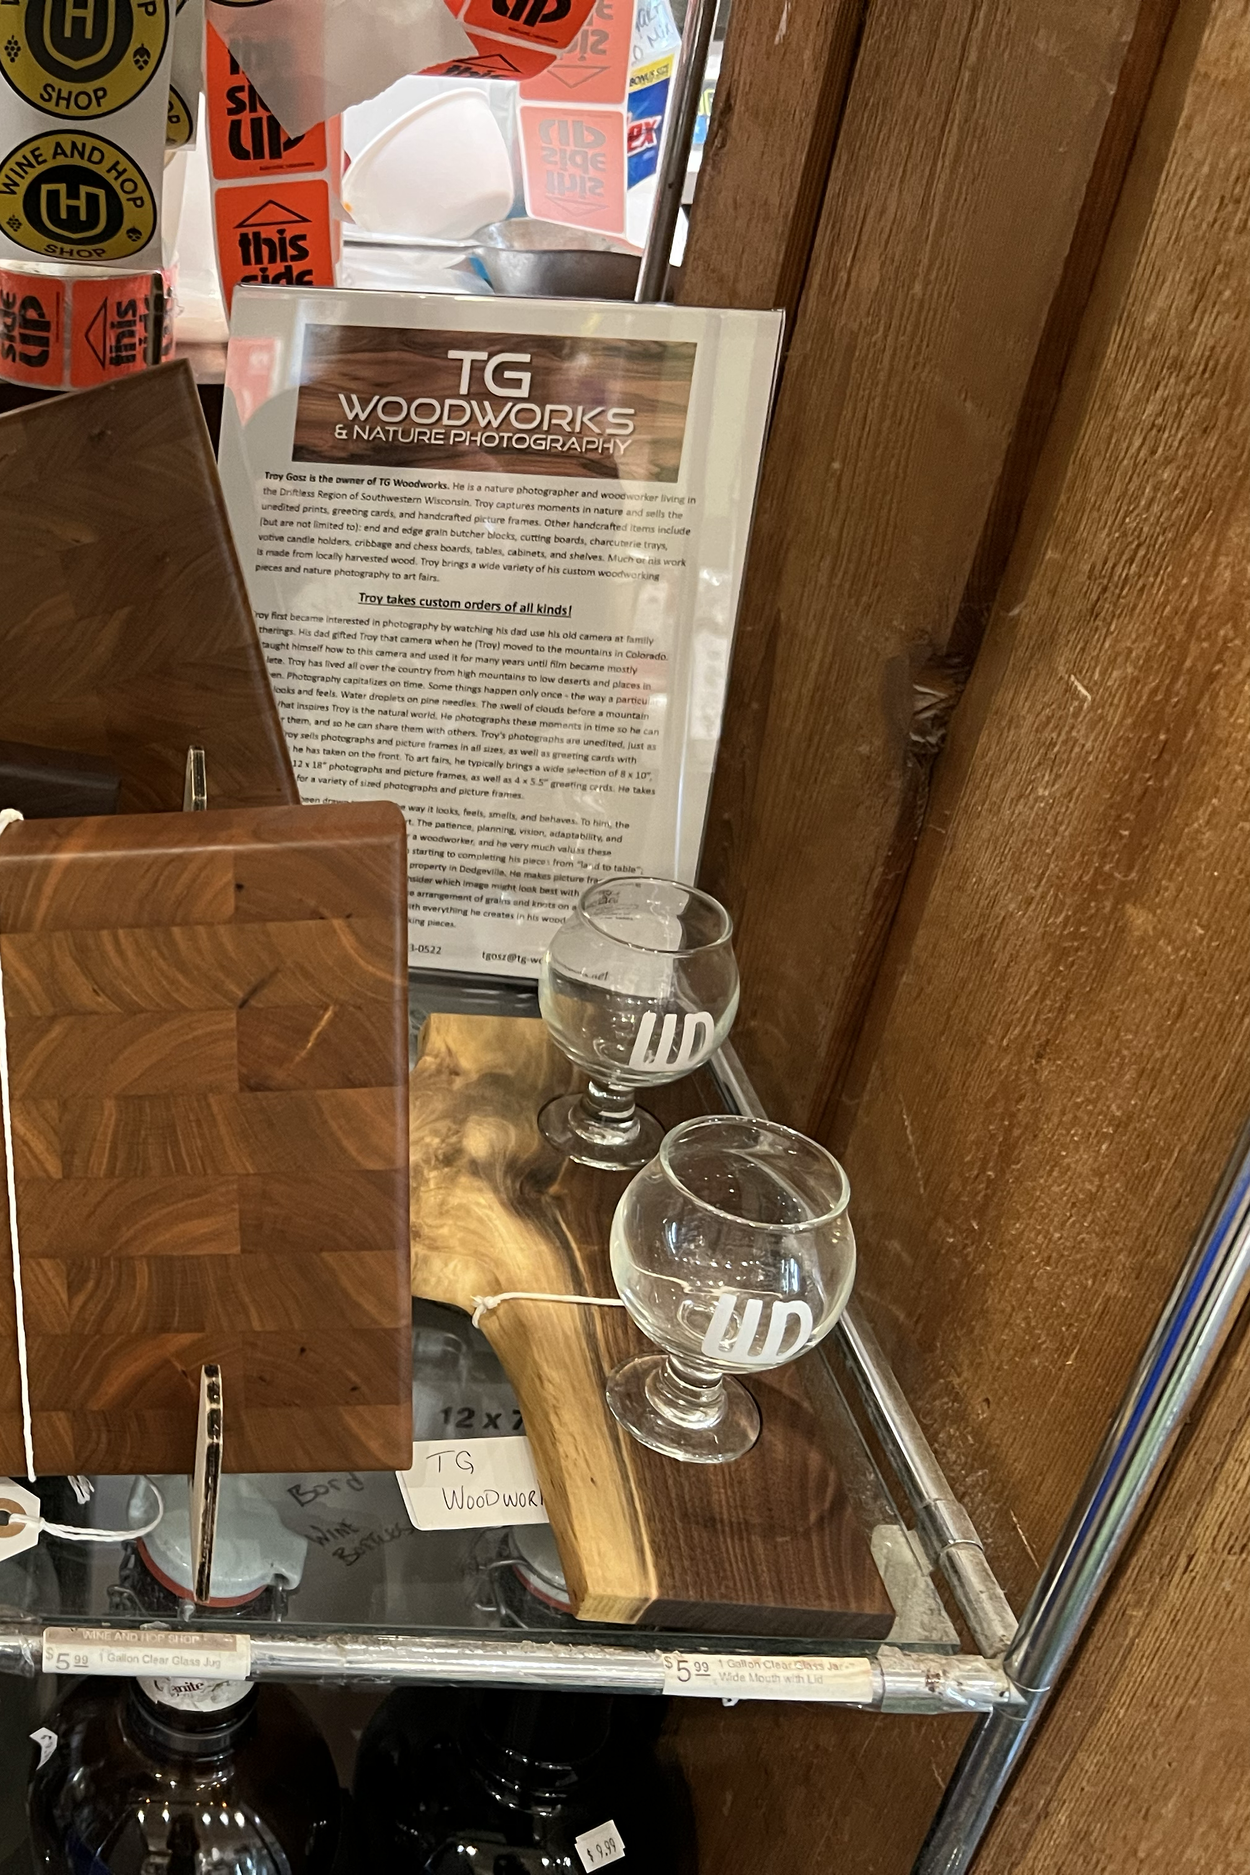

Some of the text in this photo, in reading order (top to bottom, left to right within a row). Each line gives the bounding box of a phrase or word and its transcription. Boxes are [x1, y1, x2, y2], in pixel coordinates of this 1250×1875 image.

[629, 69, 655, 87] BONUS
[39, 83, 108, 110] SHOP
[0, 140, 145, 209] WINE AND HOP
[43, 244, 106, 259] SHOP
[238, 228, 310, 267] this
[18, 295, 51, 368] UP
[109, 298, 138, 367] this
[447, 349, 532, 398] TG
[338, 393, 636, 436] WOODWORKS
[334, 424, 634, 455] & NATURE PHOTOGRAPHY
[262, 469, 284, 483] Troy
[285, 471, 307, 481] Gosz
[308, 472, 316, 482] is
[317, 472, 333, 483] the
[335, 476, 364, 485] owner
[366, 475, 377, 485] of
[378, 476, 391, 486] TG
[392, 477, 450, 489] Woodworks.
[451, 480, 465, 490] He
[466, 481, 474, 491] is
[483, 482, 514, 493] nature
[515, 483, 578, 499] photographer
[580, 487, 599, 498] and
[600, 488, 658, 501] woodworker
[659, 491, 685, 505] living
[686, 493, 698, 503] in
[260, 500, 692, 535] unedited prints, greeting cards, and handcrafted picture frames. Other handcrafted items include
[357, 591, 573, 615] Troy takes custom orders of all kinds!
[295, 773, 308, 783] for
[317, 775, 347, 788] variety
[348, 777, 359, 787] of
[359, 778, 382, 788] sized
[382, 779, 438, 795] photographs
[439, 784, 457, 794] and
[457, 785, 490, 799] picture
[491, 787, 526, 799] frames.
[416, 818, 623, 843] The patience, planning, vision, adaptability, and
[441, 1406, 475, 1429] 12
[426, 1450, 475, 1475] TG
[82, 1630, 111, 1641] WINE
[113, 1631, 139, 1642] AND
[167, 1634, 200, 1644] SHOP
[106, 1652, 140, 1664] Gallon
[142, 1654, 169, 1665] Clear
[171, 1656, 201, 1667] Glass
[202, 1657, 222, 1669] Jug
[726, 1659, 761, 1669] Gallon
[763, 1660, 793, 1670] Clear
[718, 1672, 823, 1684] Wide Mouth with Lid
